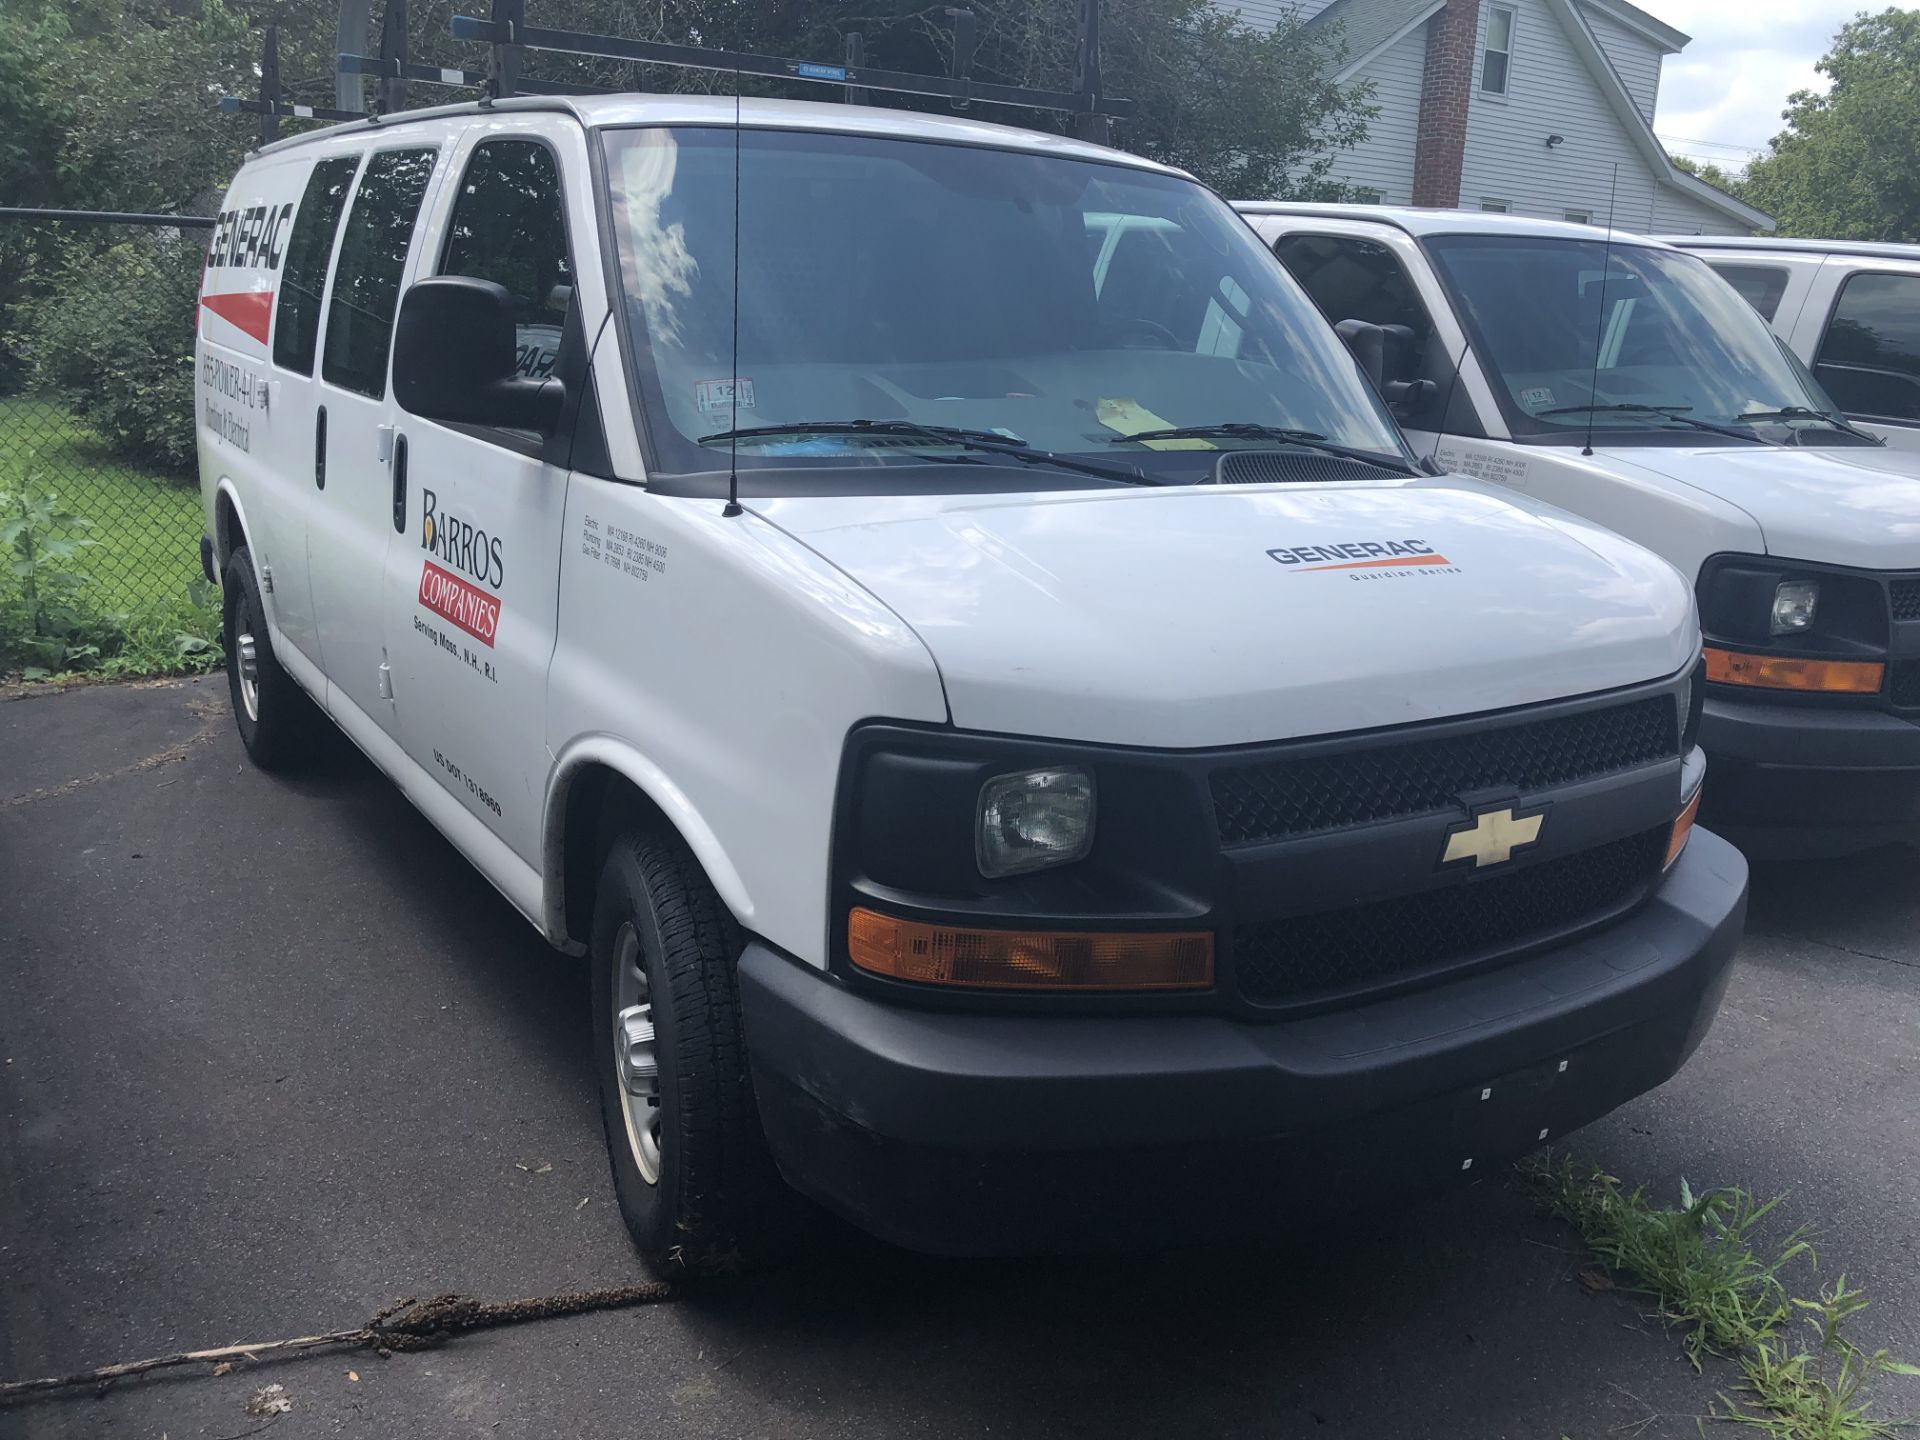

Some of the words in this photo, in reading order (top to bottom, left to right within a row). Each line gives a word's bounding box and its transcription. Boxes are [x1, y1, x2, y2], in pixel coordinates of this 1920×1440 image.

[207, 203, 294, 271] GENERAC
[716, 384, 735, 397] 12
[1532, 391, 1543, 399] 12
[421, 488, 503, 589] BARROS
[646, 540, 654, 554] NH
[645, 554, 653, 569] NH
[1265, 539, 1435, 565] GENERAC
[1349, 569, 1413, 581] Guardian
[1418, 567, 1463, 577] Series
[422, 569, 497, 638] COMPANIES
[413, 615, 438, 647] Serving
[439, 631, 462, 661] Mass.,
[463, 648, 482, 675] N.H.,
[484, 661, 498, 685] R.I.
[433, 748, 444, 767] US
[445, 757, 461, 782] DOT
